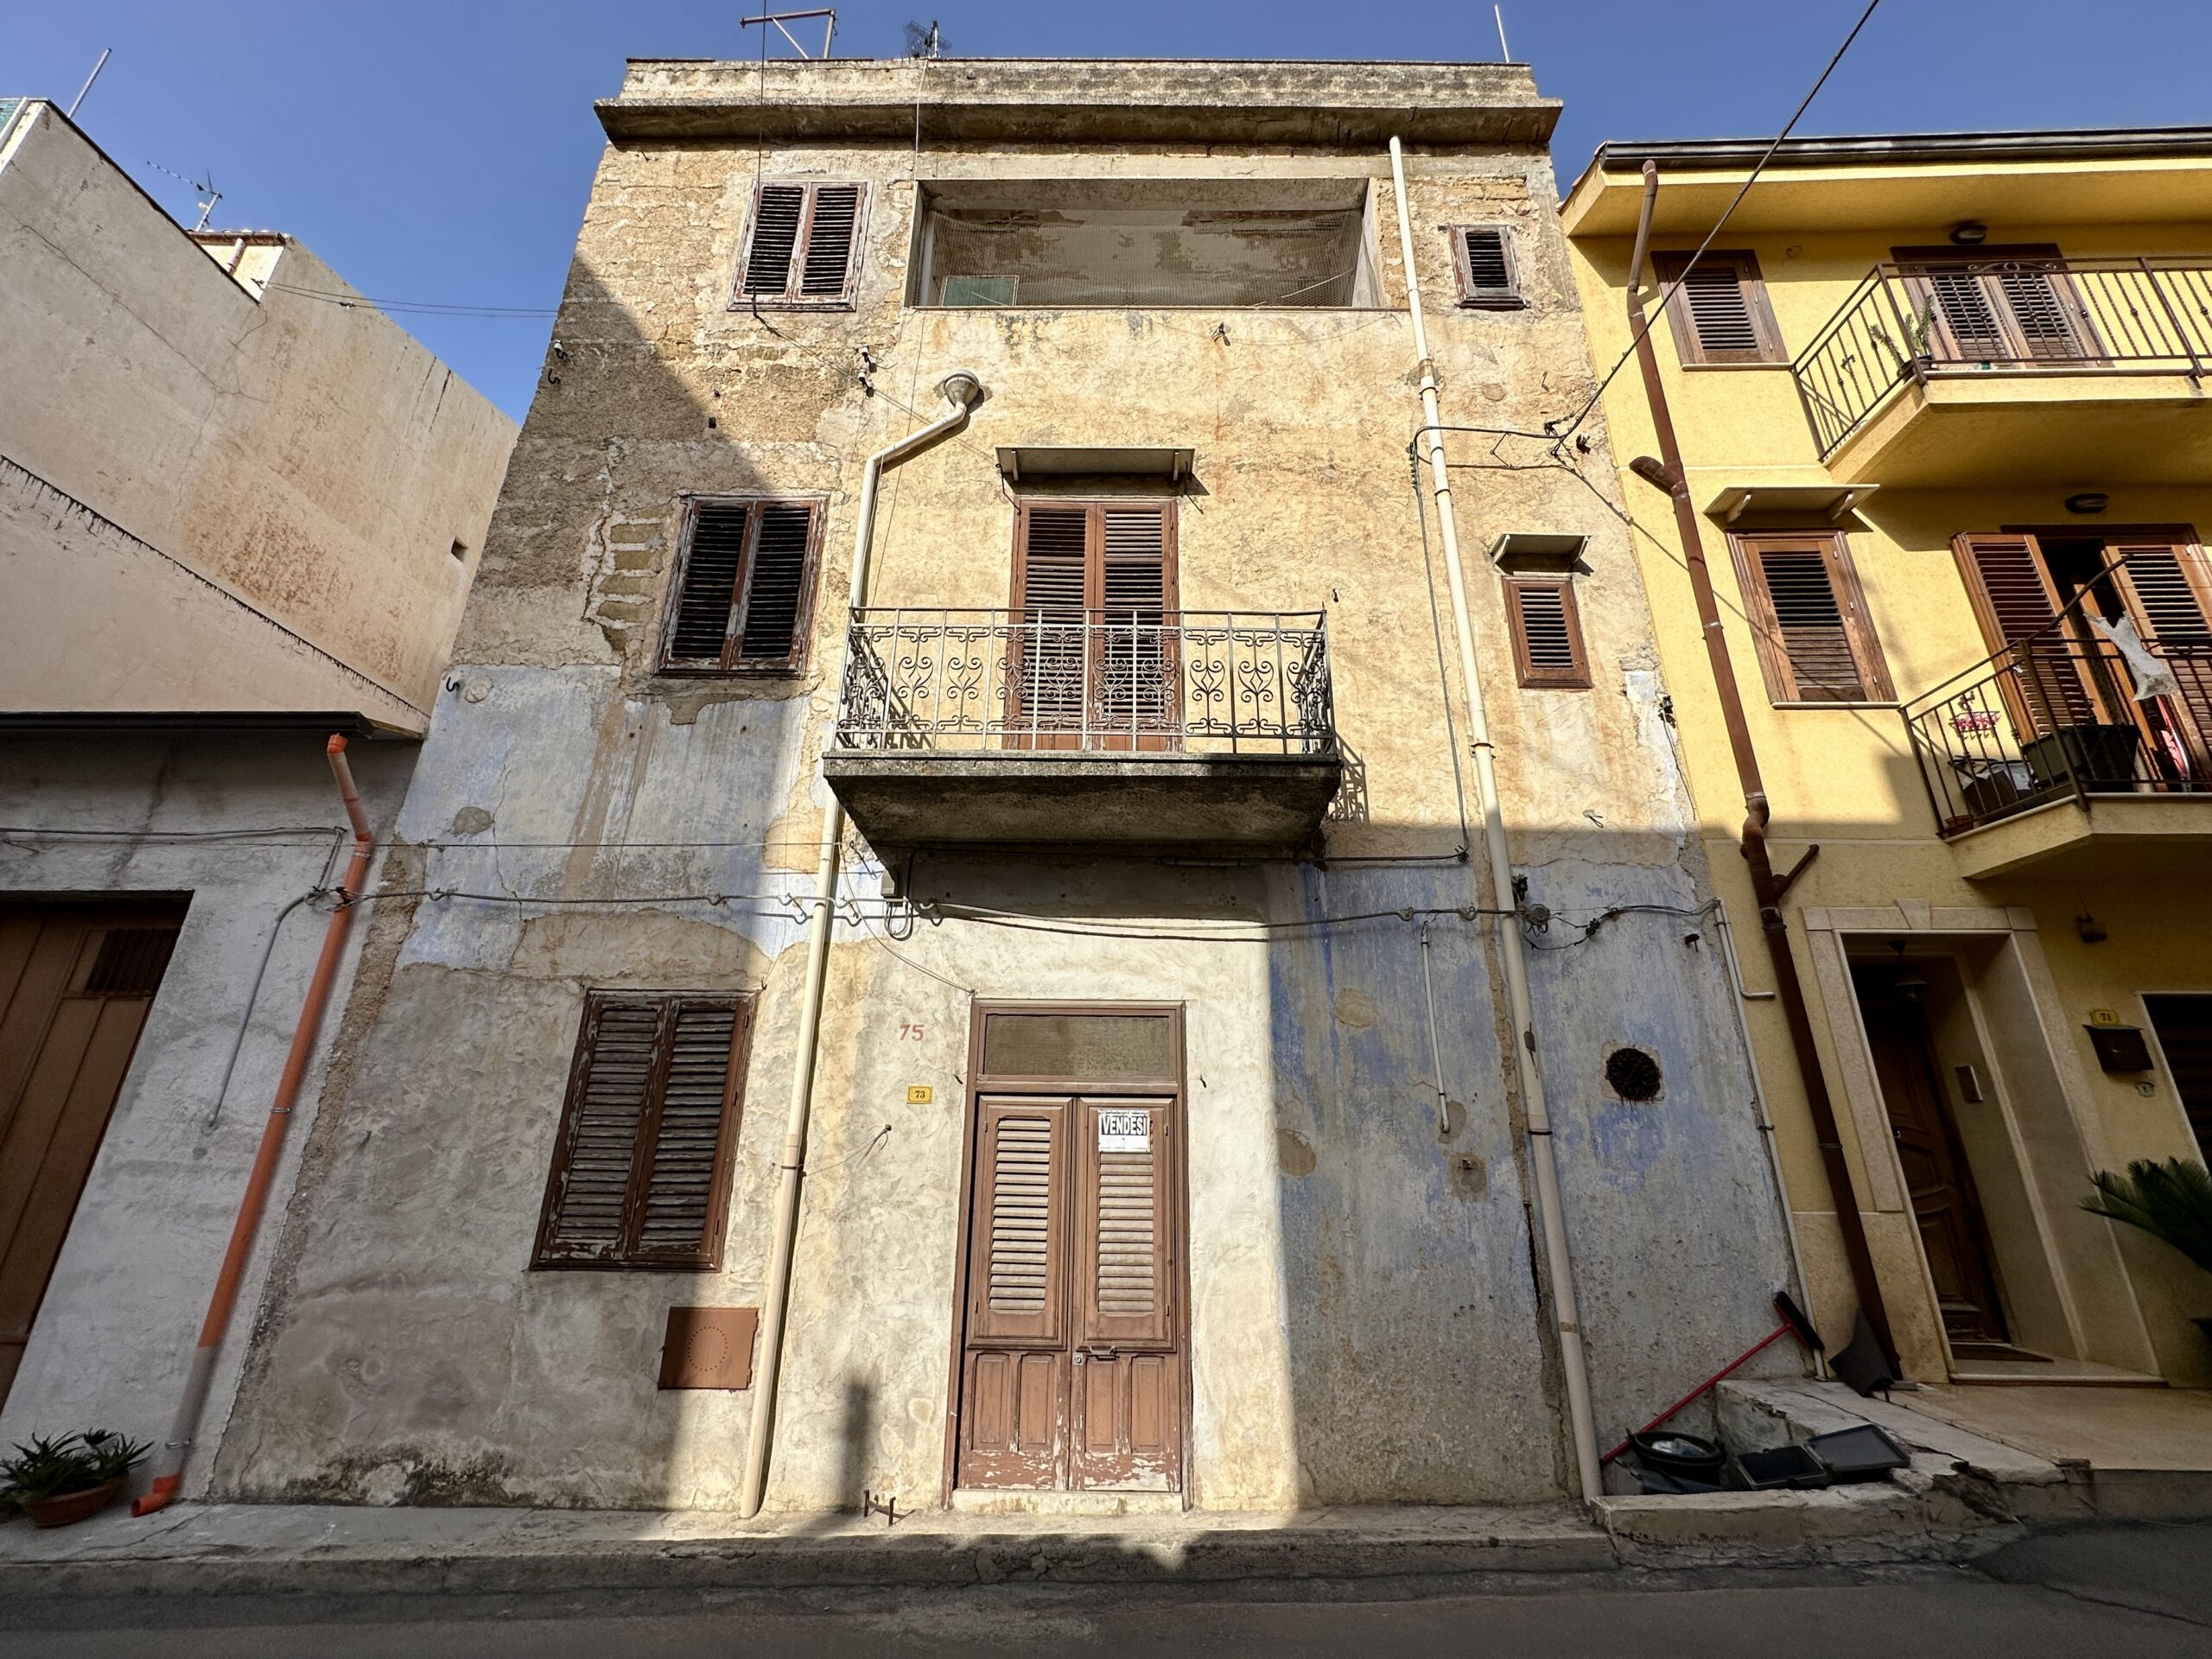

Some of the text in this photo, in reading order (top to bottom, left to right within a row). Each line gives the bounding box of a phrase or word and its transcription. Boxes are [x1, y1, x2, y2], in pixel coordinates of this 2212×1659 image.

[899, 1024, 925, 1041] 75
[914, 1090, 925, 1099] 73
[1102, 1116, 1147, 1135] VENDESI
